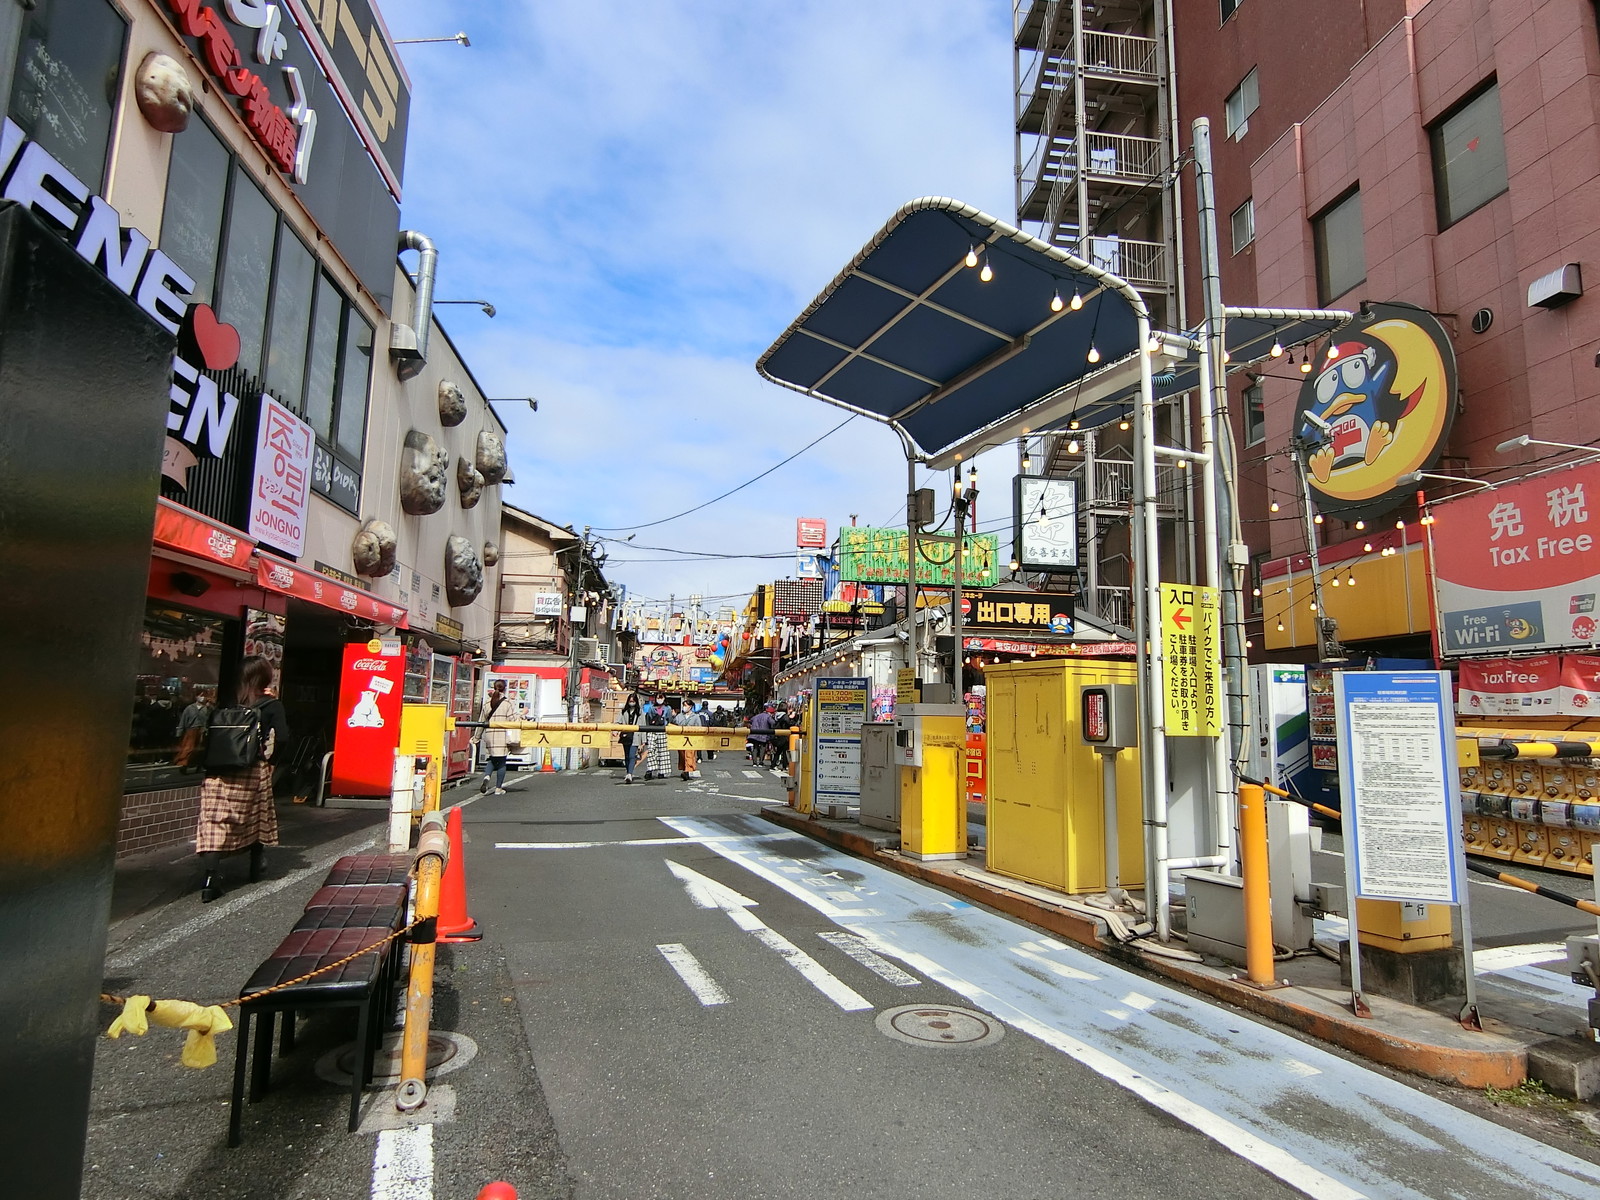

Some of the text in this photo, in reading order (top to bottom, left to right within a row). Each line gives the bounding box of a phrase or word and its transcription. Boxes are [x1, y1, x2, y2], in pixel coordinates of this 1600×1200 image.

[255, 508, 301, 540] JONGNO
[1488, 483, 1589, 542] 免税
[1490, 534, 1593, 567] Tax Free
[977, 600, 1052, 626] 出口専用
[1169, 589, 1195, 606] 入口
[1455, 626, 1500, 646] Wi-Fi
[1463, 615, 1488, 626] Free
[353, 658, 389, 671] Coca-Cola
[1169, 633, 1181, 715] ご入場ください。
[1188, 634, 1199, 715] 駐車場入口より、
[1203, 612, 1216, 729] バイクでご来店の方へ
[1481, 670, 1539, 684] Tax Free
[1178, 634, 1190, 732] 駐車券をお取り頂き
